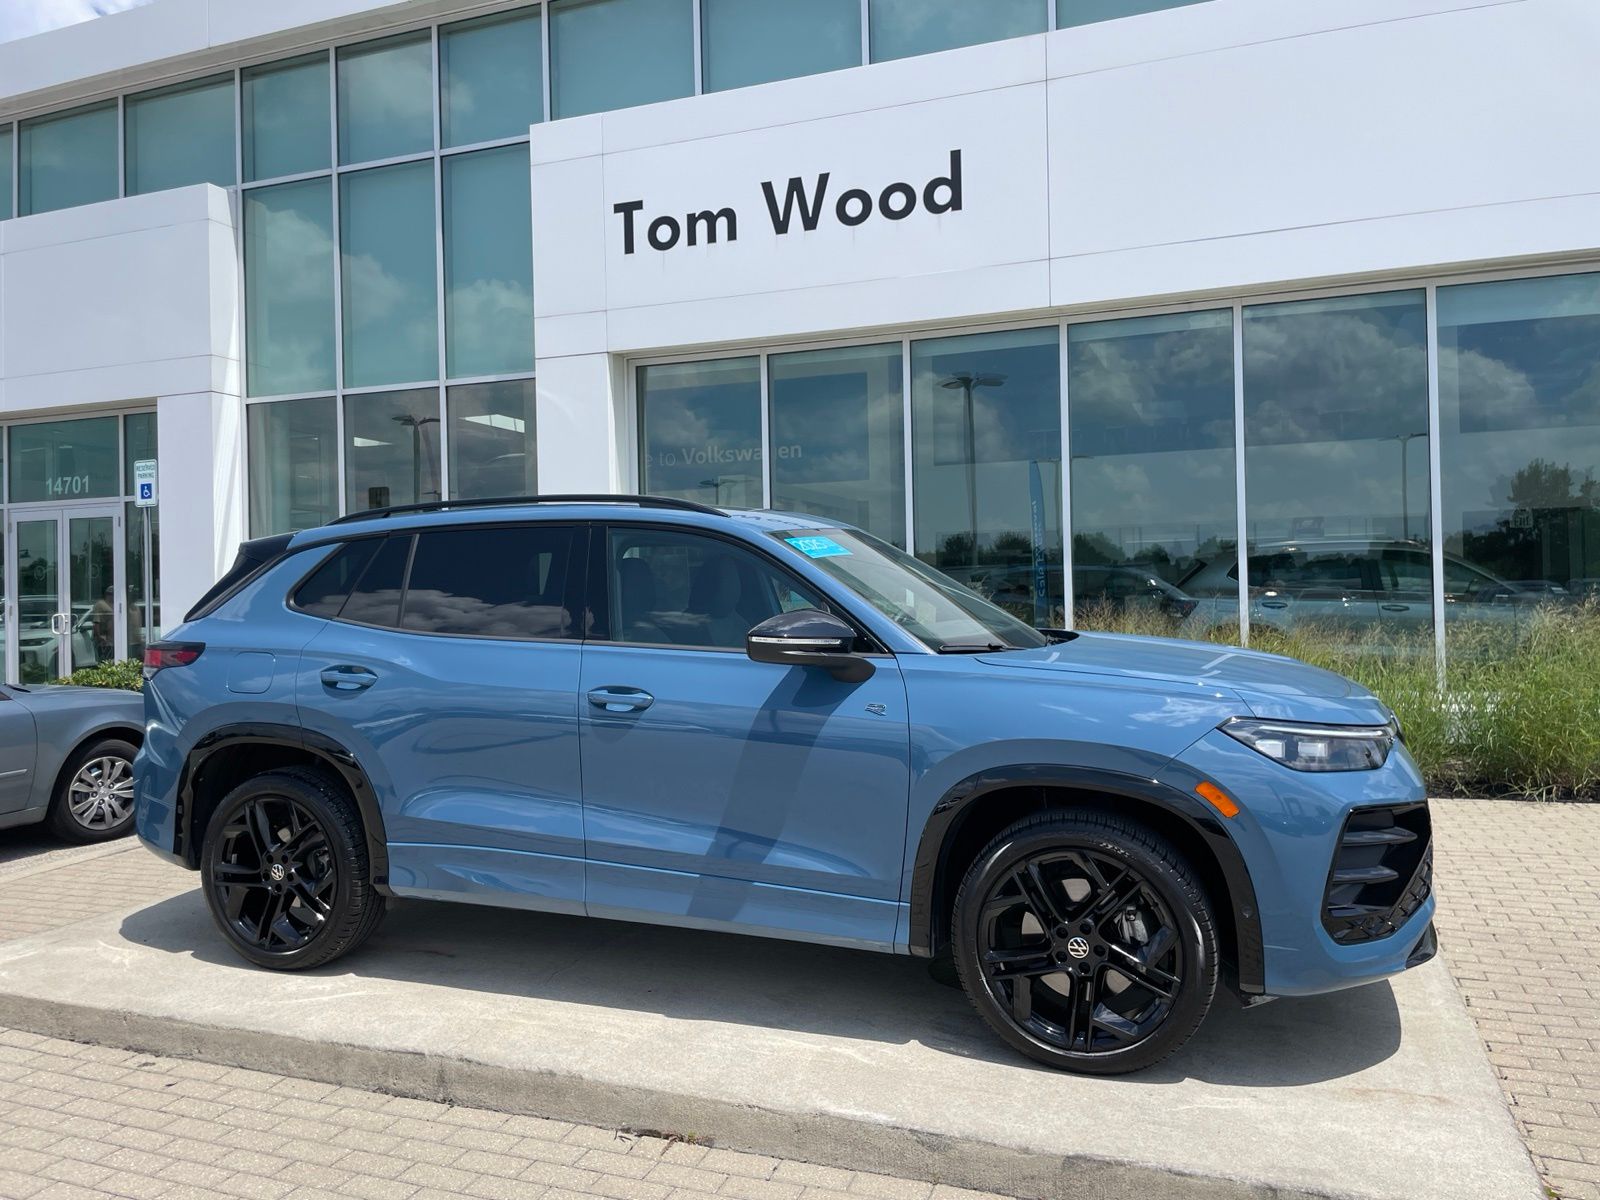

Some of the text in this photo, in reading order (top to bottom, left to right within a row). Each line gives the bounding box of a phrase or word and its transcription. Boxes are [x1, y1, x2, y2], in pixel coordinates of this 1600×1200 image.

[613, 149, 963, 255] Tom Wood
[659, 453, 677, 467] to
[682, 445, 802, 465] Volkswaen
[46, 475, 89, 495] 14701
